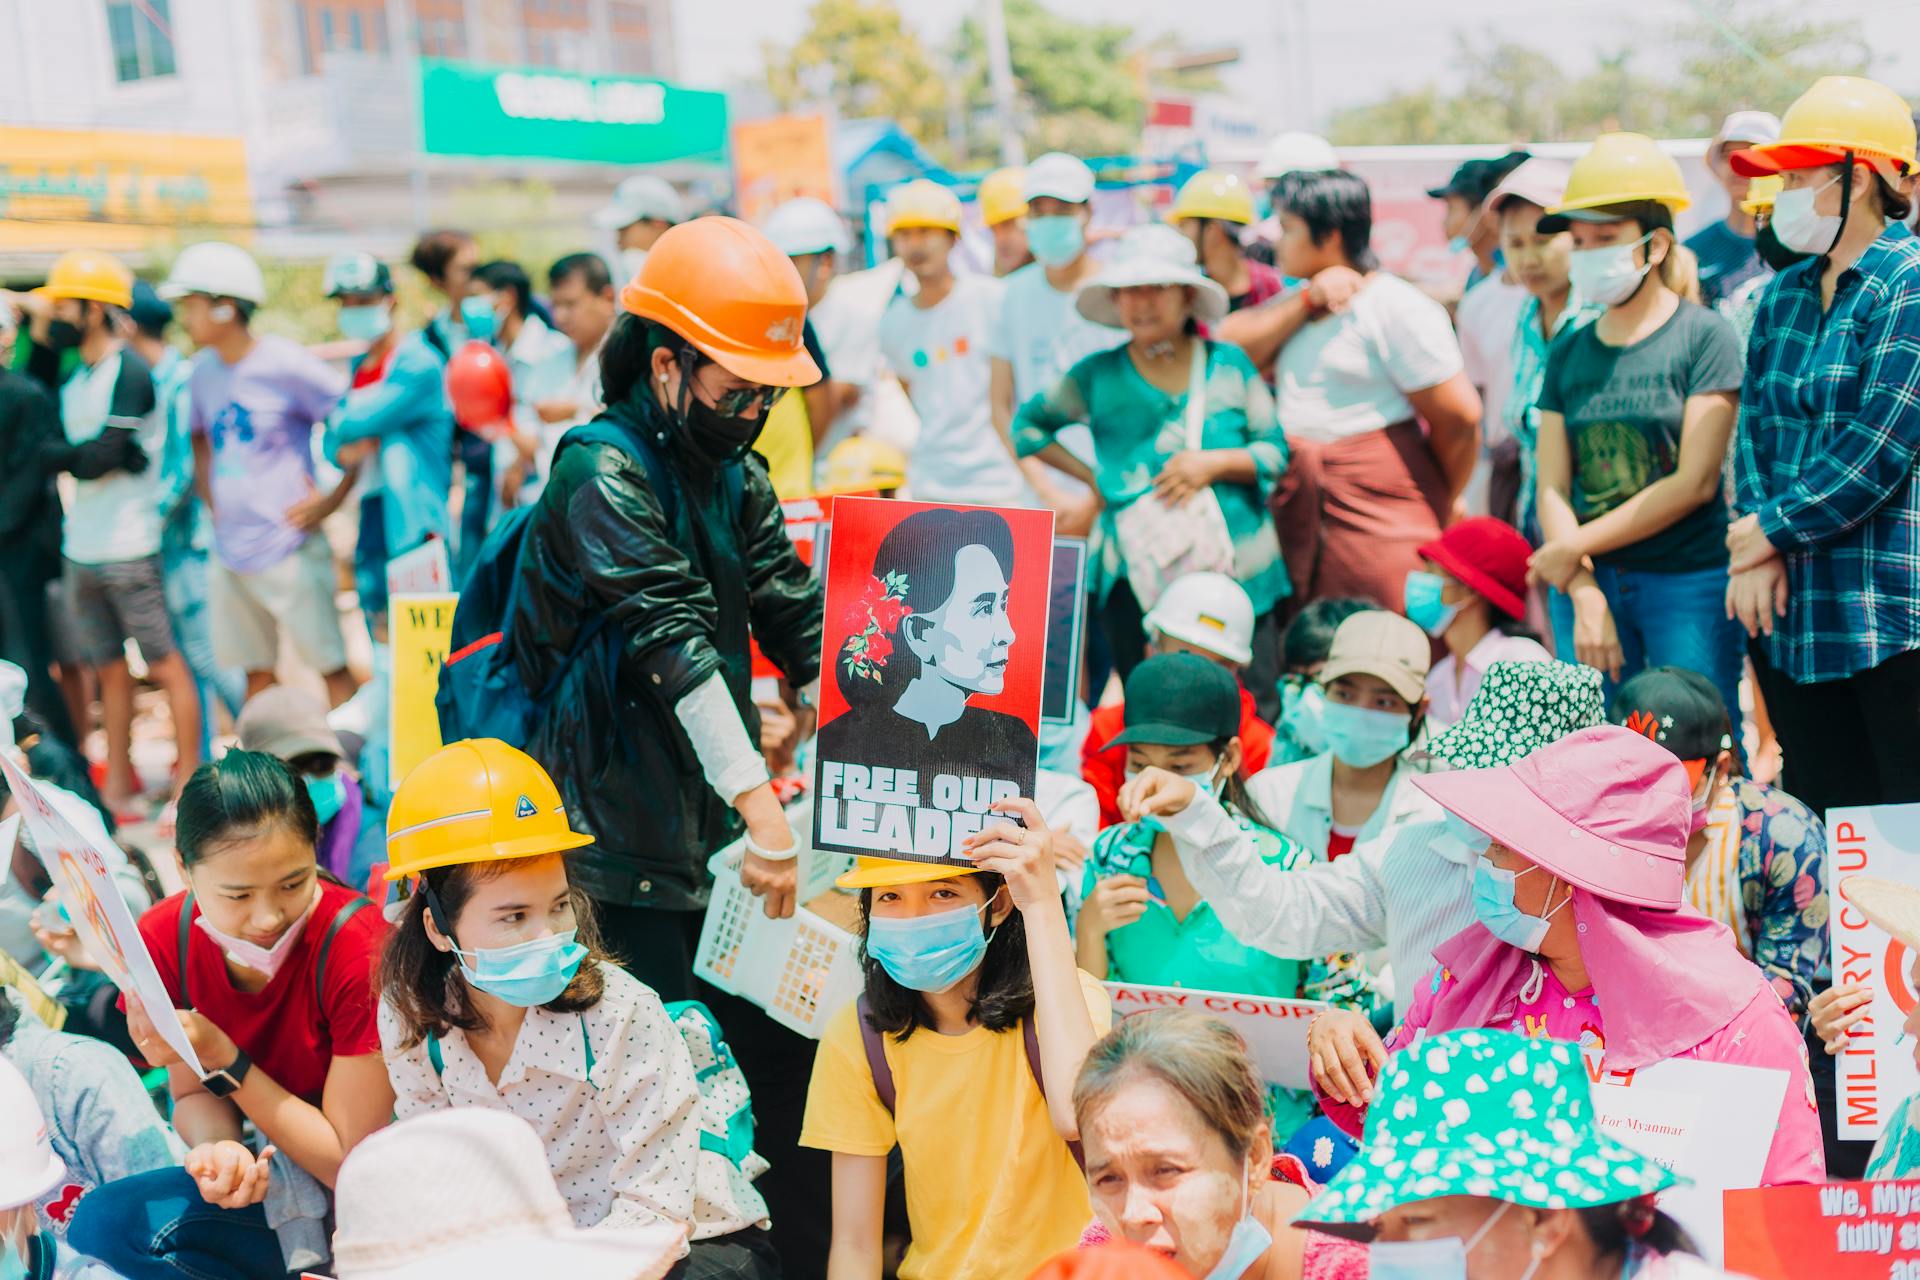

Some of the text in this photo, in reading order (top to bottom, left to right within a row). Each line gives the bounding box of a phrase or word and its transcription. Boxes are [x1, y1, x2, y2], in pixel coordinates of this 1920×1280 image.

[407, 606, 450, 629] WE
[821, 760, 1023, 818] FREE OUR
[1105, 987, 1315, 1019] ARY COUP
[1600, 1114, 1686, 1137] For Myanmar
[1819, 1186, 1867, 1218] We,
[1837, 1220, 1894, 1255] fully
